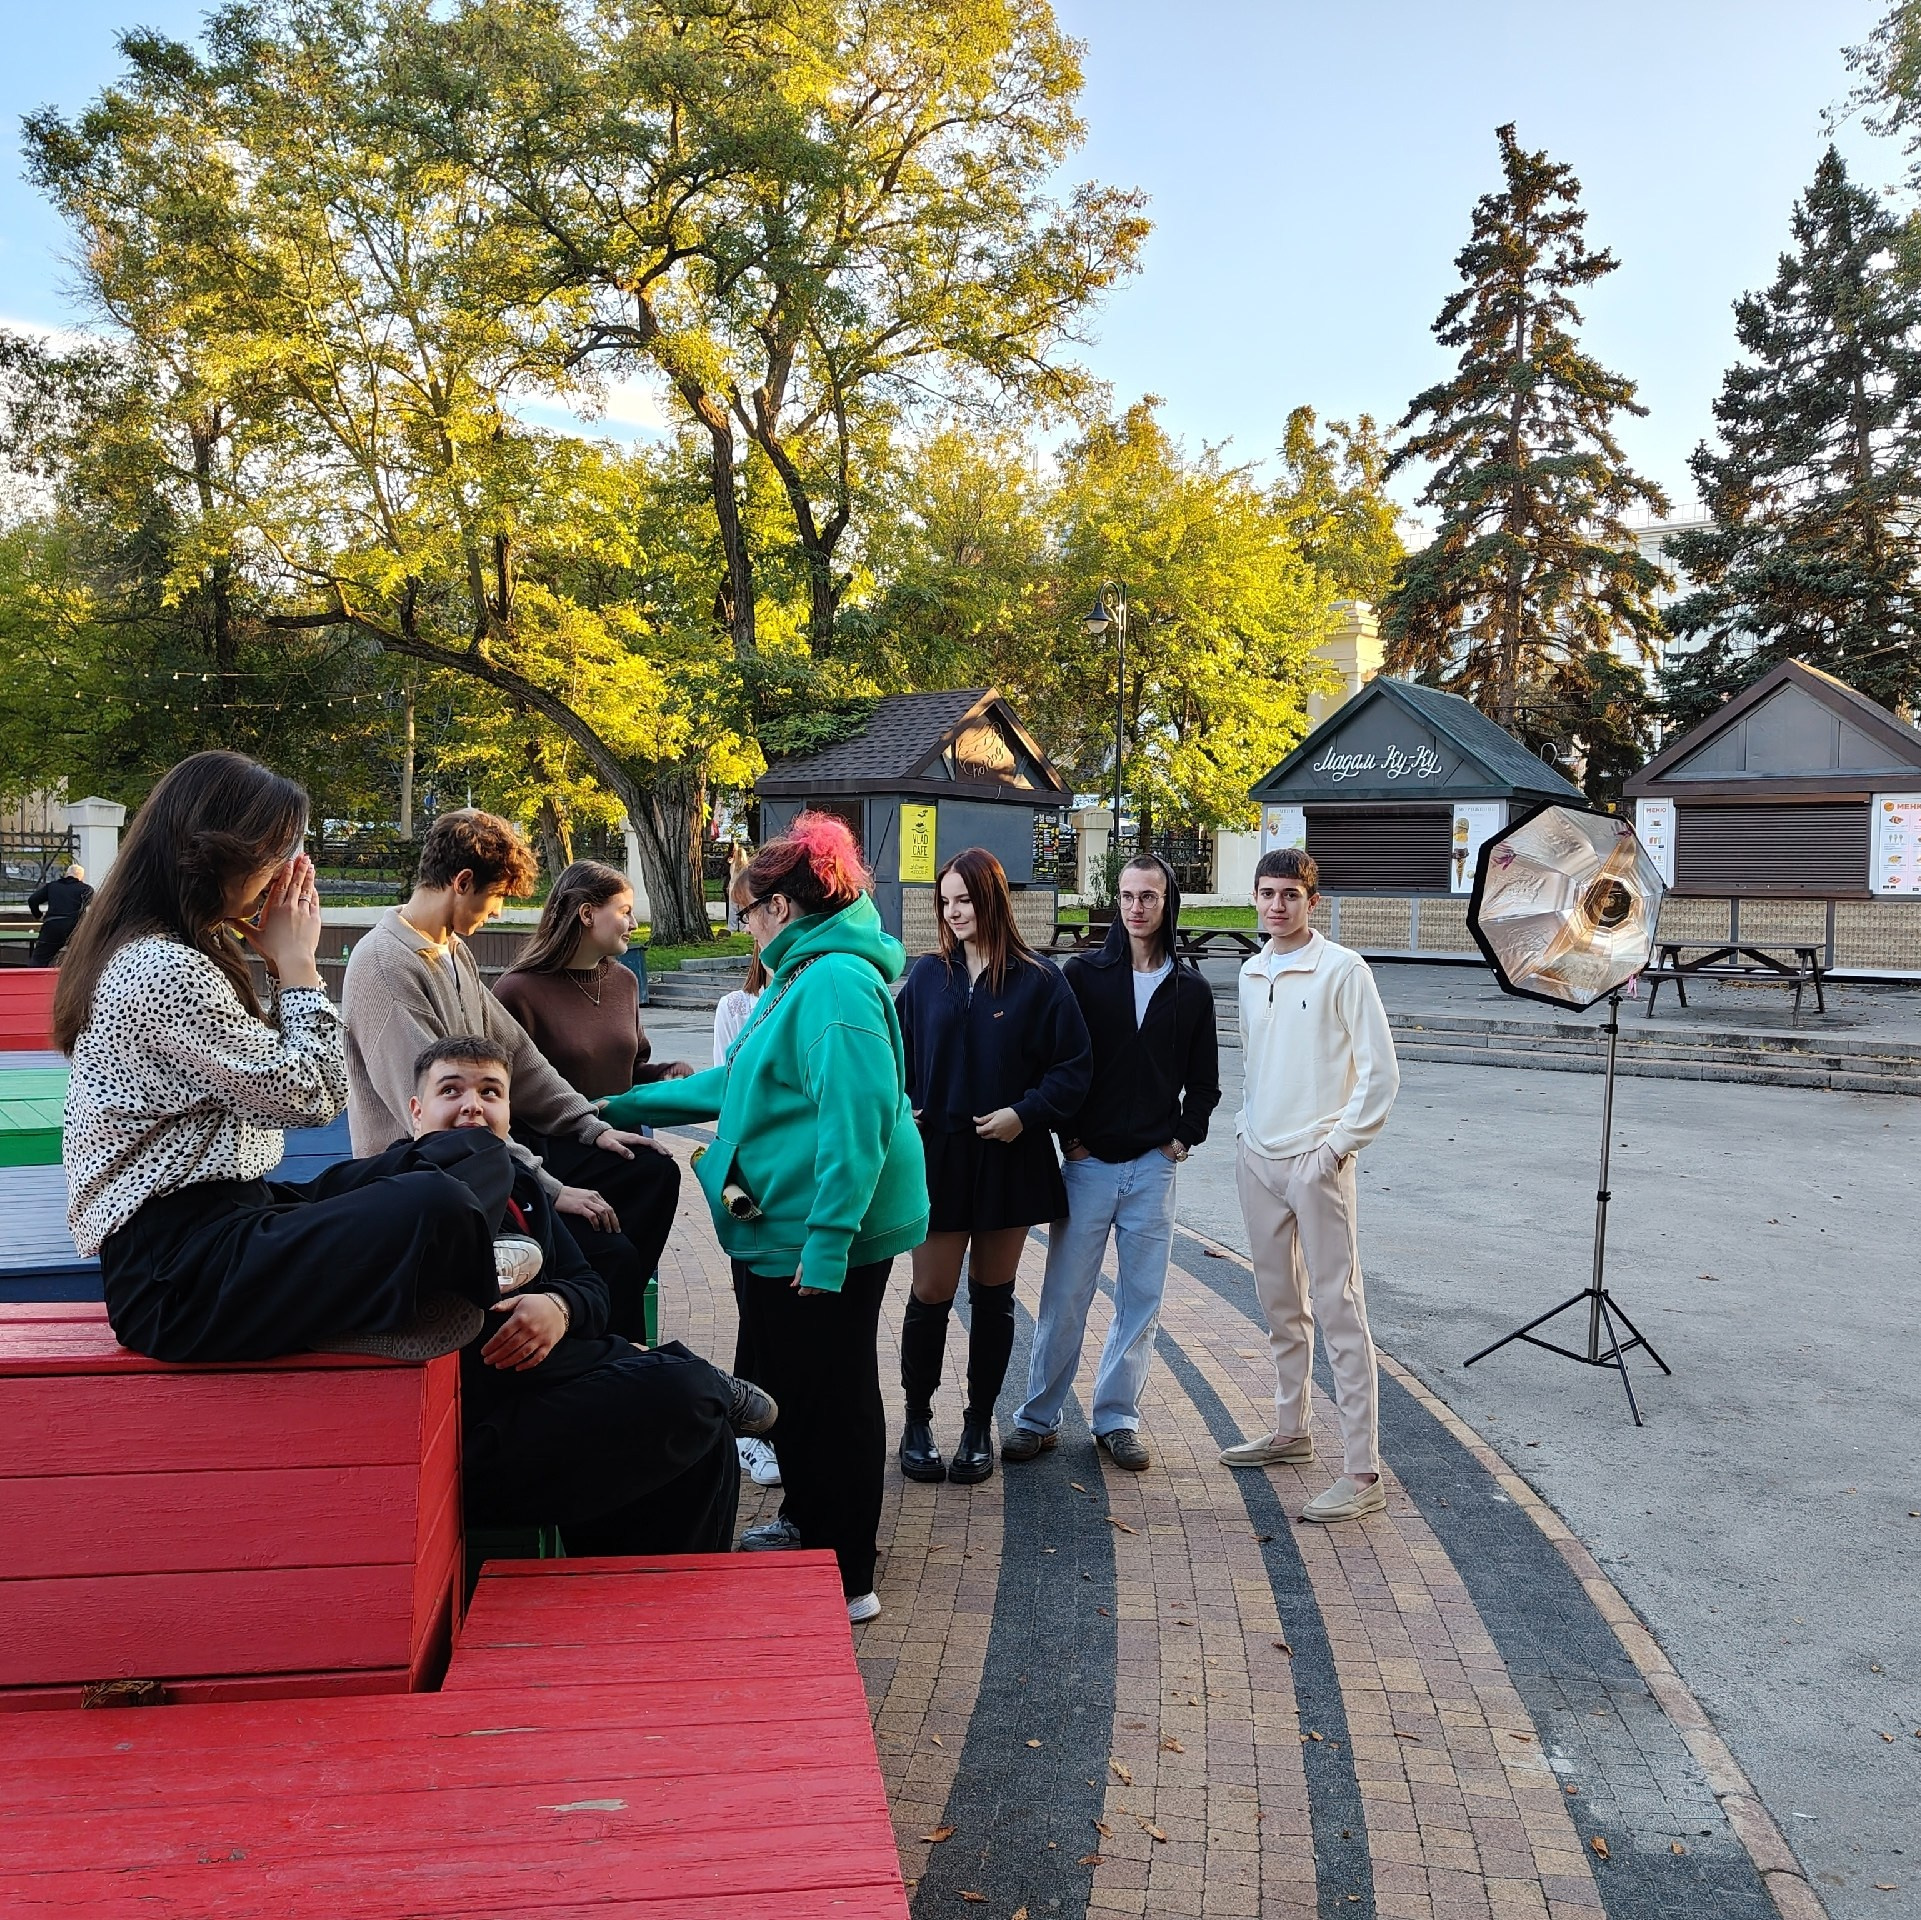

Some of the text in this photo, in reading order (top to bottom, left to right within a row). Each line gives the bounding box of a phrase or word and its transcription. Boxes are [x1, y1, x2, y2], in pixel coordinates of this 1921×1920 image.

[1313, 744, 1442, 782] Мадам Ку-Ку
[912, 833, 929, 845] VLAD
[912, 845, 928, 856] CAFE
